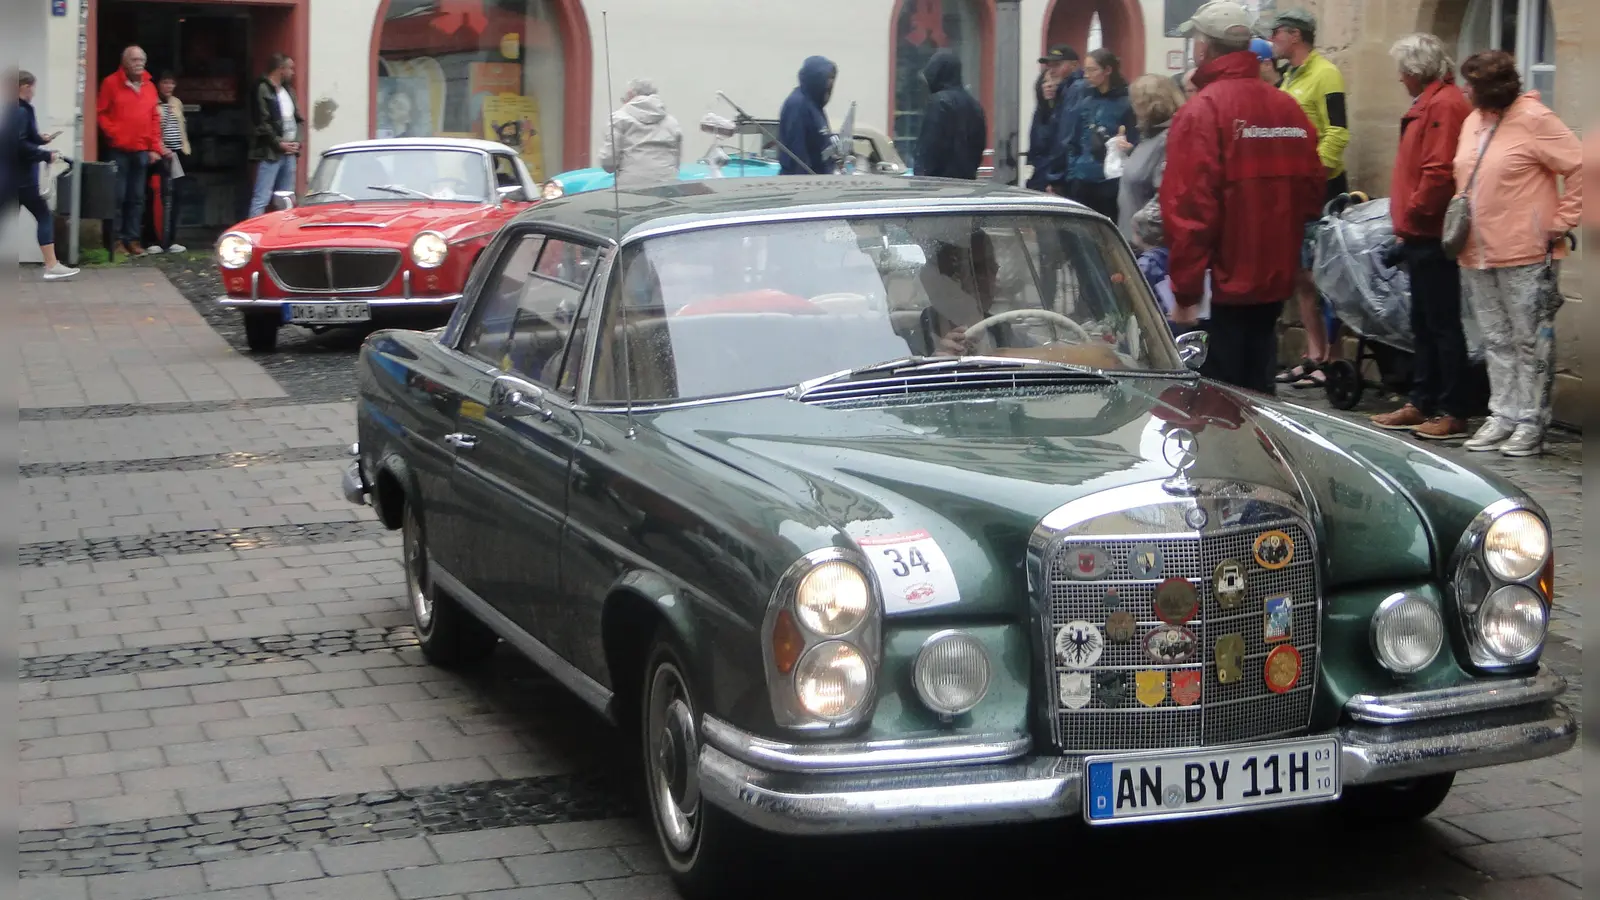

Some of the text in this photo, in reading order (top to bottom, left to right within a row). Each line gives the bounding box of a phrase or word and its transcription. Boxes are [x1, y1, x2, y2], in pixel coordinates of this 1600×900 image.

[883, 546, 931, 577] 34
[1314, 748, 1331, 761] 03
[1116, 751, 1309, 809] AN BY 11H
[1316, 778, 1331, 789] 10
